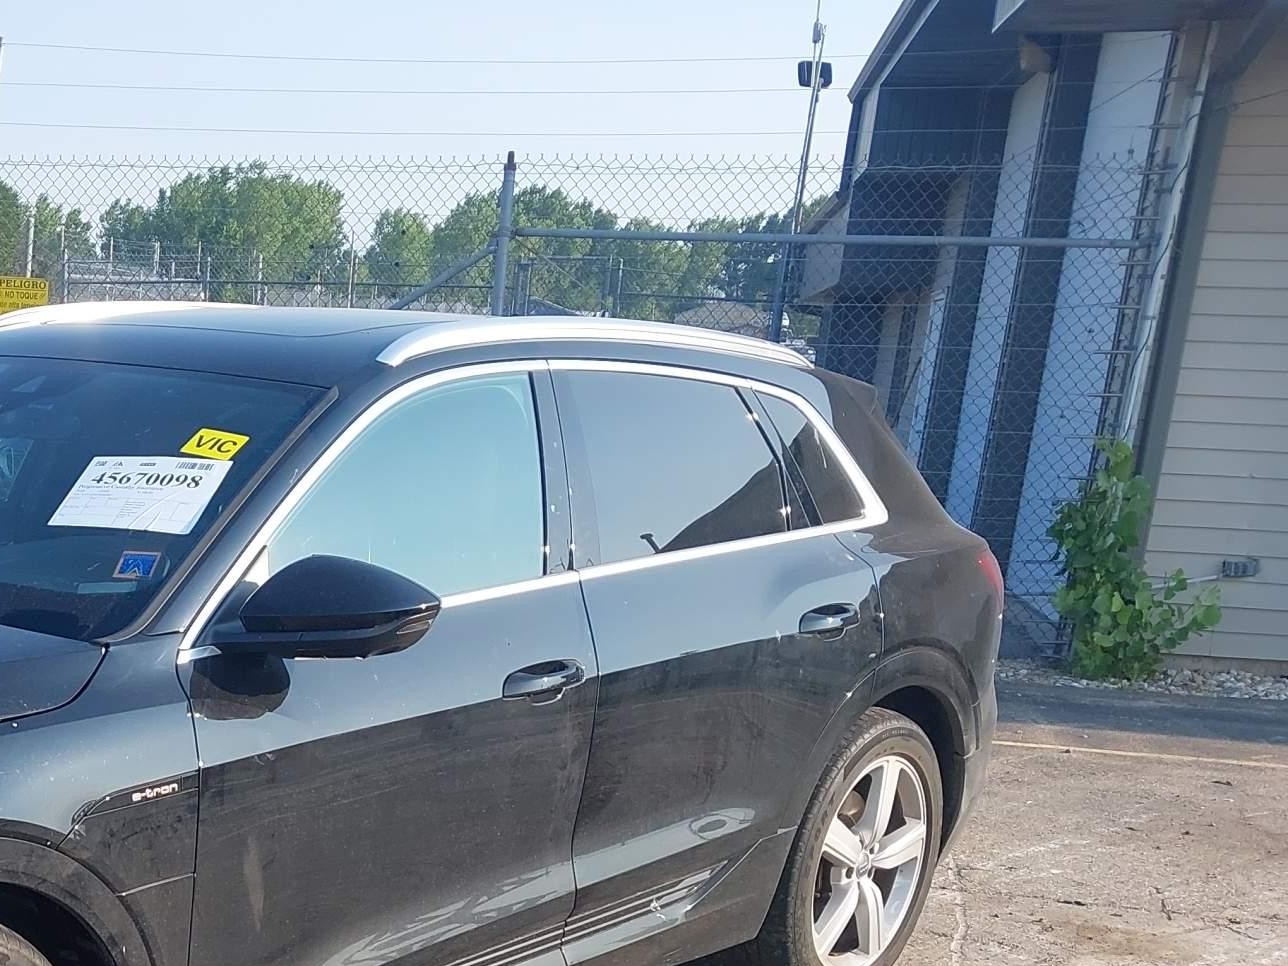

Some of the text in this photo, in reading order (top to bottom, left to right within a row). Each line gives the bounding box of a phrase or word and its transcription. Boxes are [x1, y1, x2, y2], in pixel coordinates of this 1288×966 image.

[0, 279, 47, 290] PELIGRO
[4, 291, 39, 300] NO TOQUE
[196, 434, 238, 453] VIC
[91, 471, 203, 489] 45670098
[131, 782, 179, 802] e-tron
